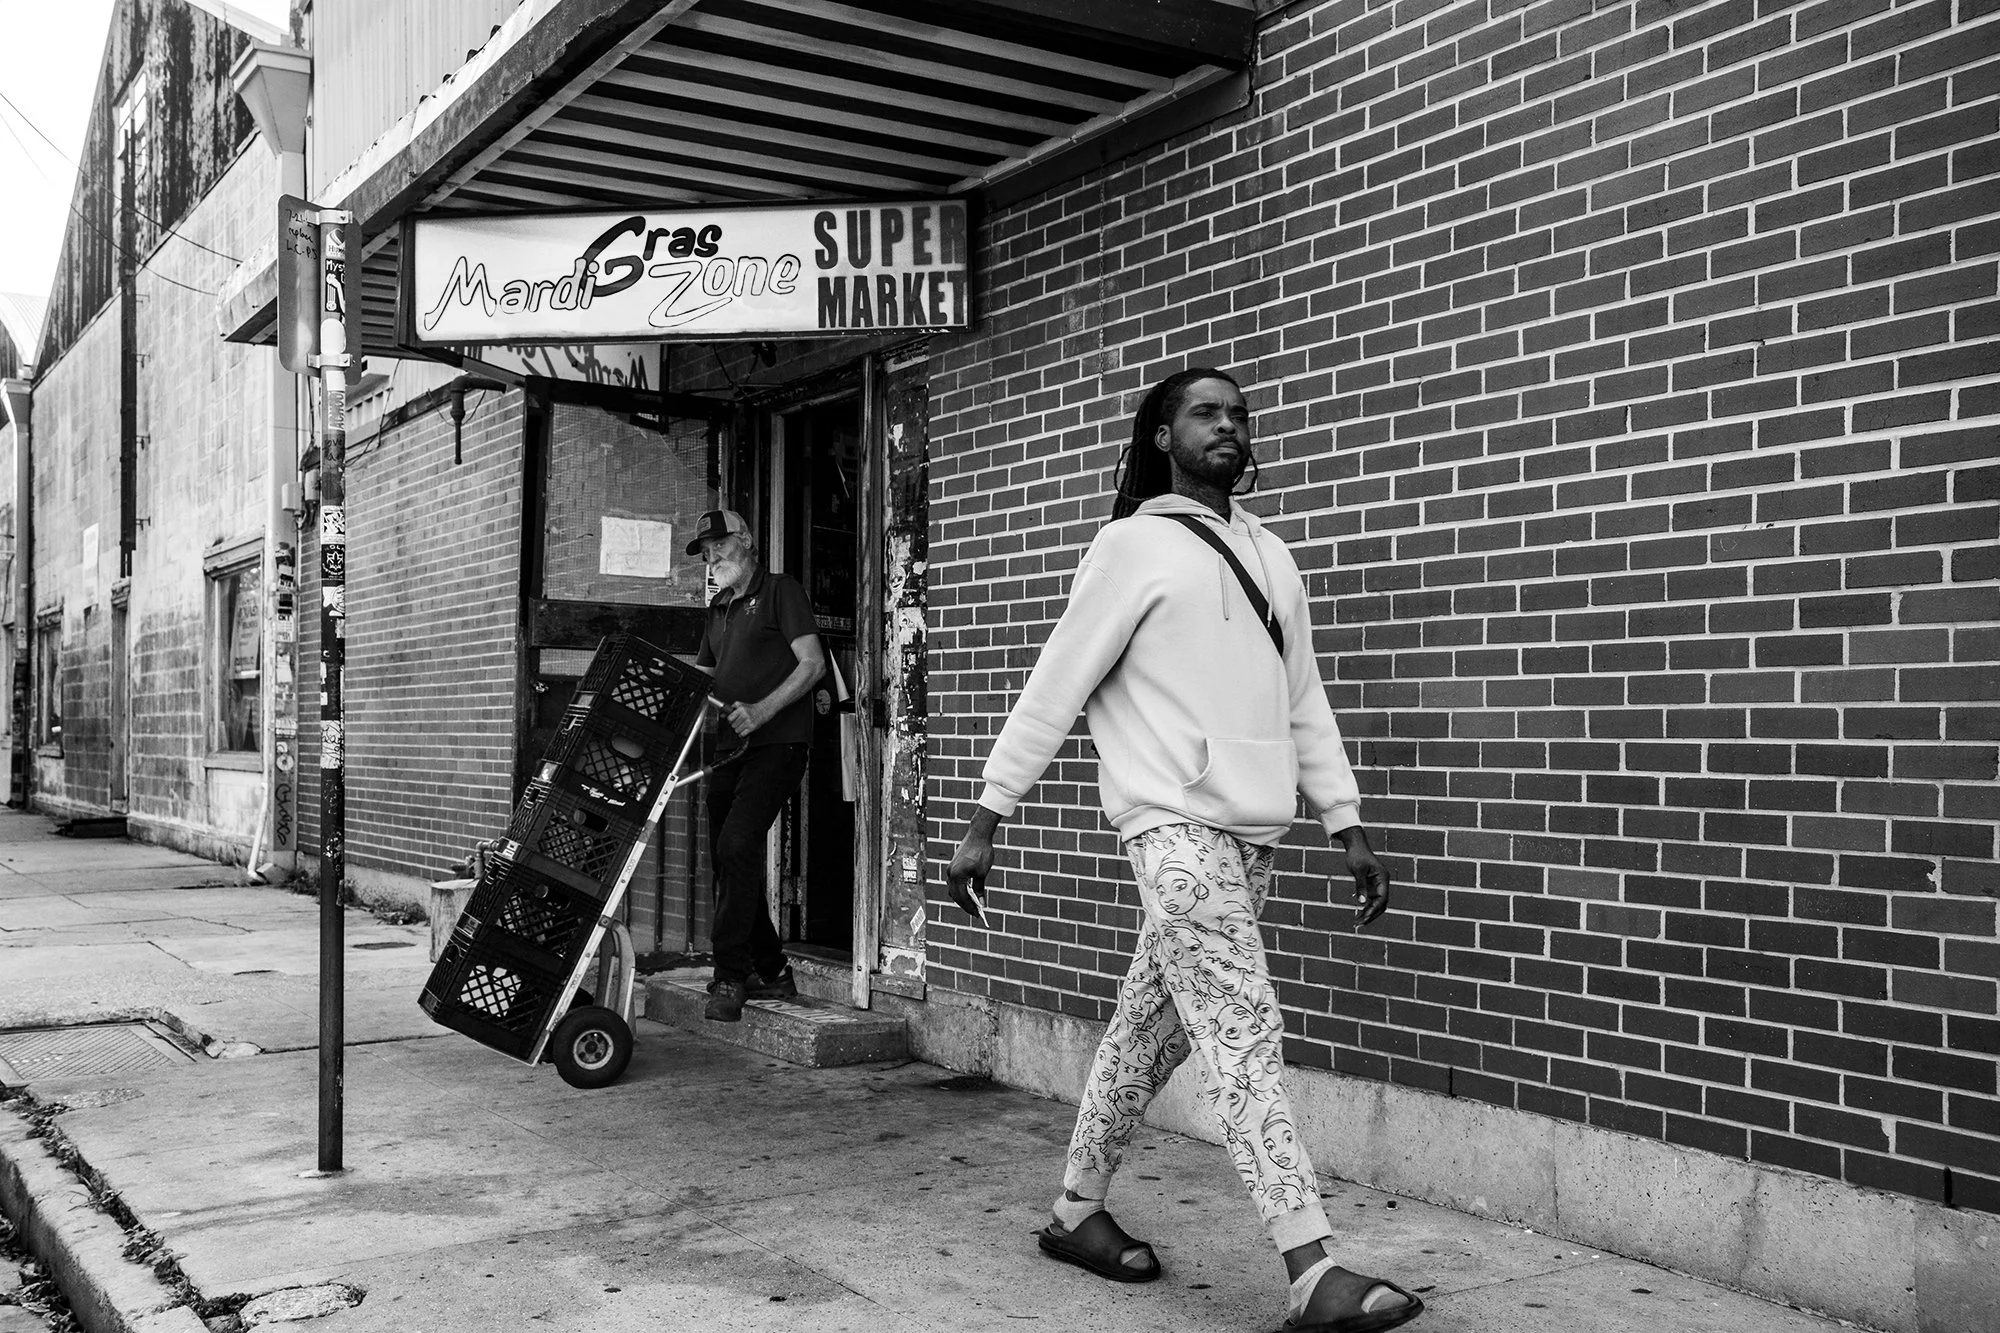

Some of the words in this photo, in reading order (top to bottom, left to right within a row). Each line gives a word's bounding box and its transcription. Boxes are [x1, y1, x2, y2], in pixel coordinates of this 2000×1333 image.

[579, 216, 722, 297] Gras
[814, 205, 966, 270] SUPER
[424, 256, 600, 331] Mardi
[648, 254, 802, 328] Zone
[817, 270, 967, 329] MARKET
